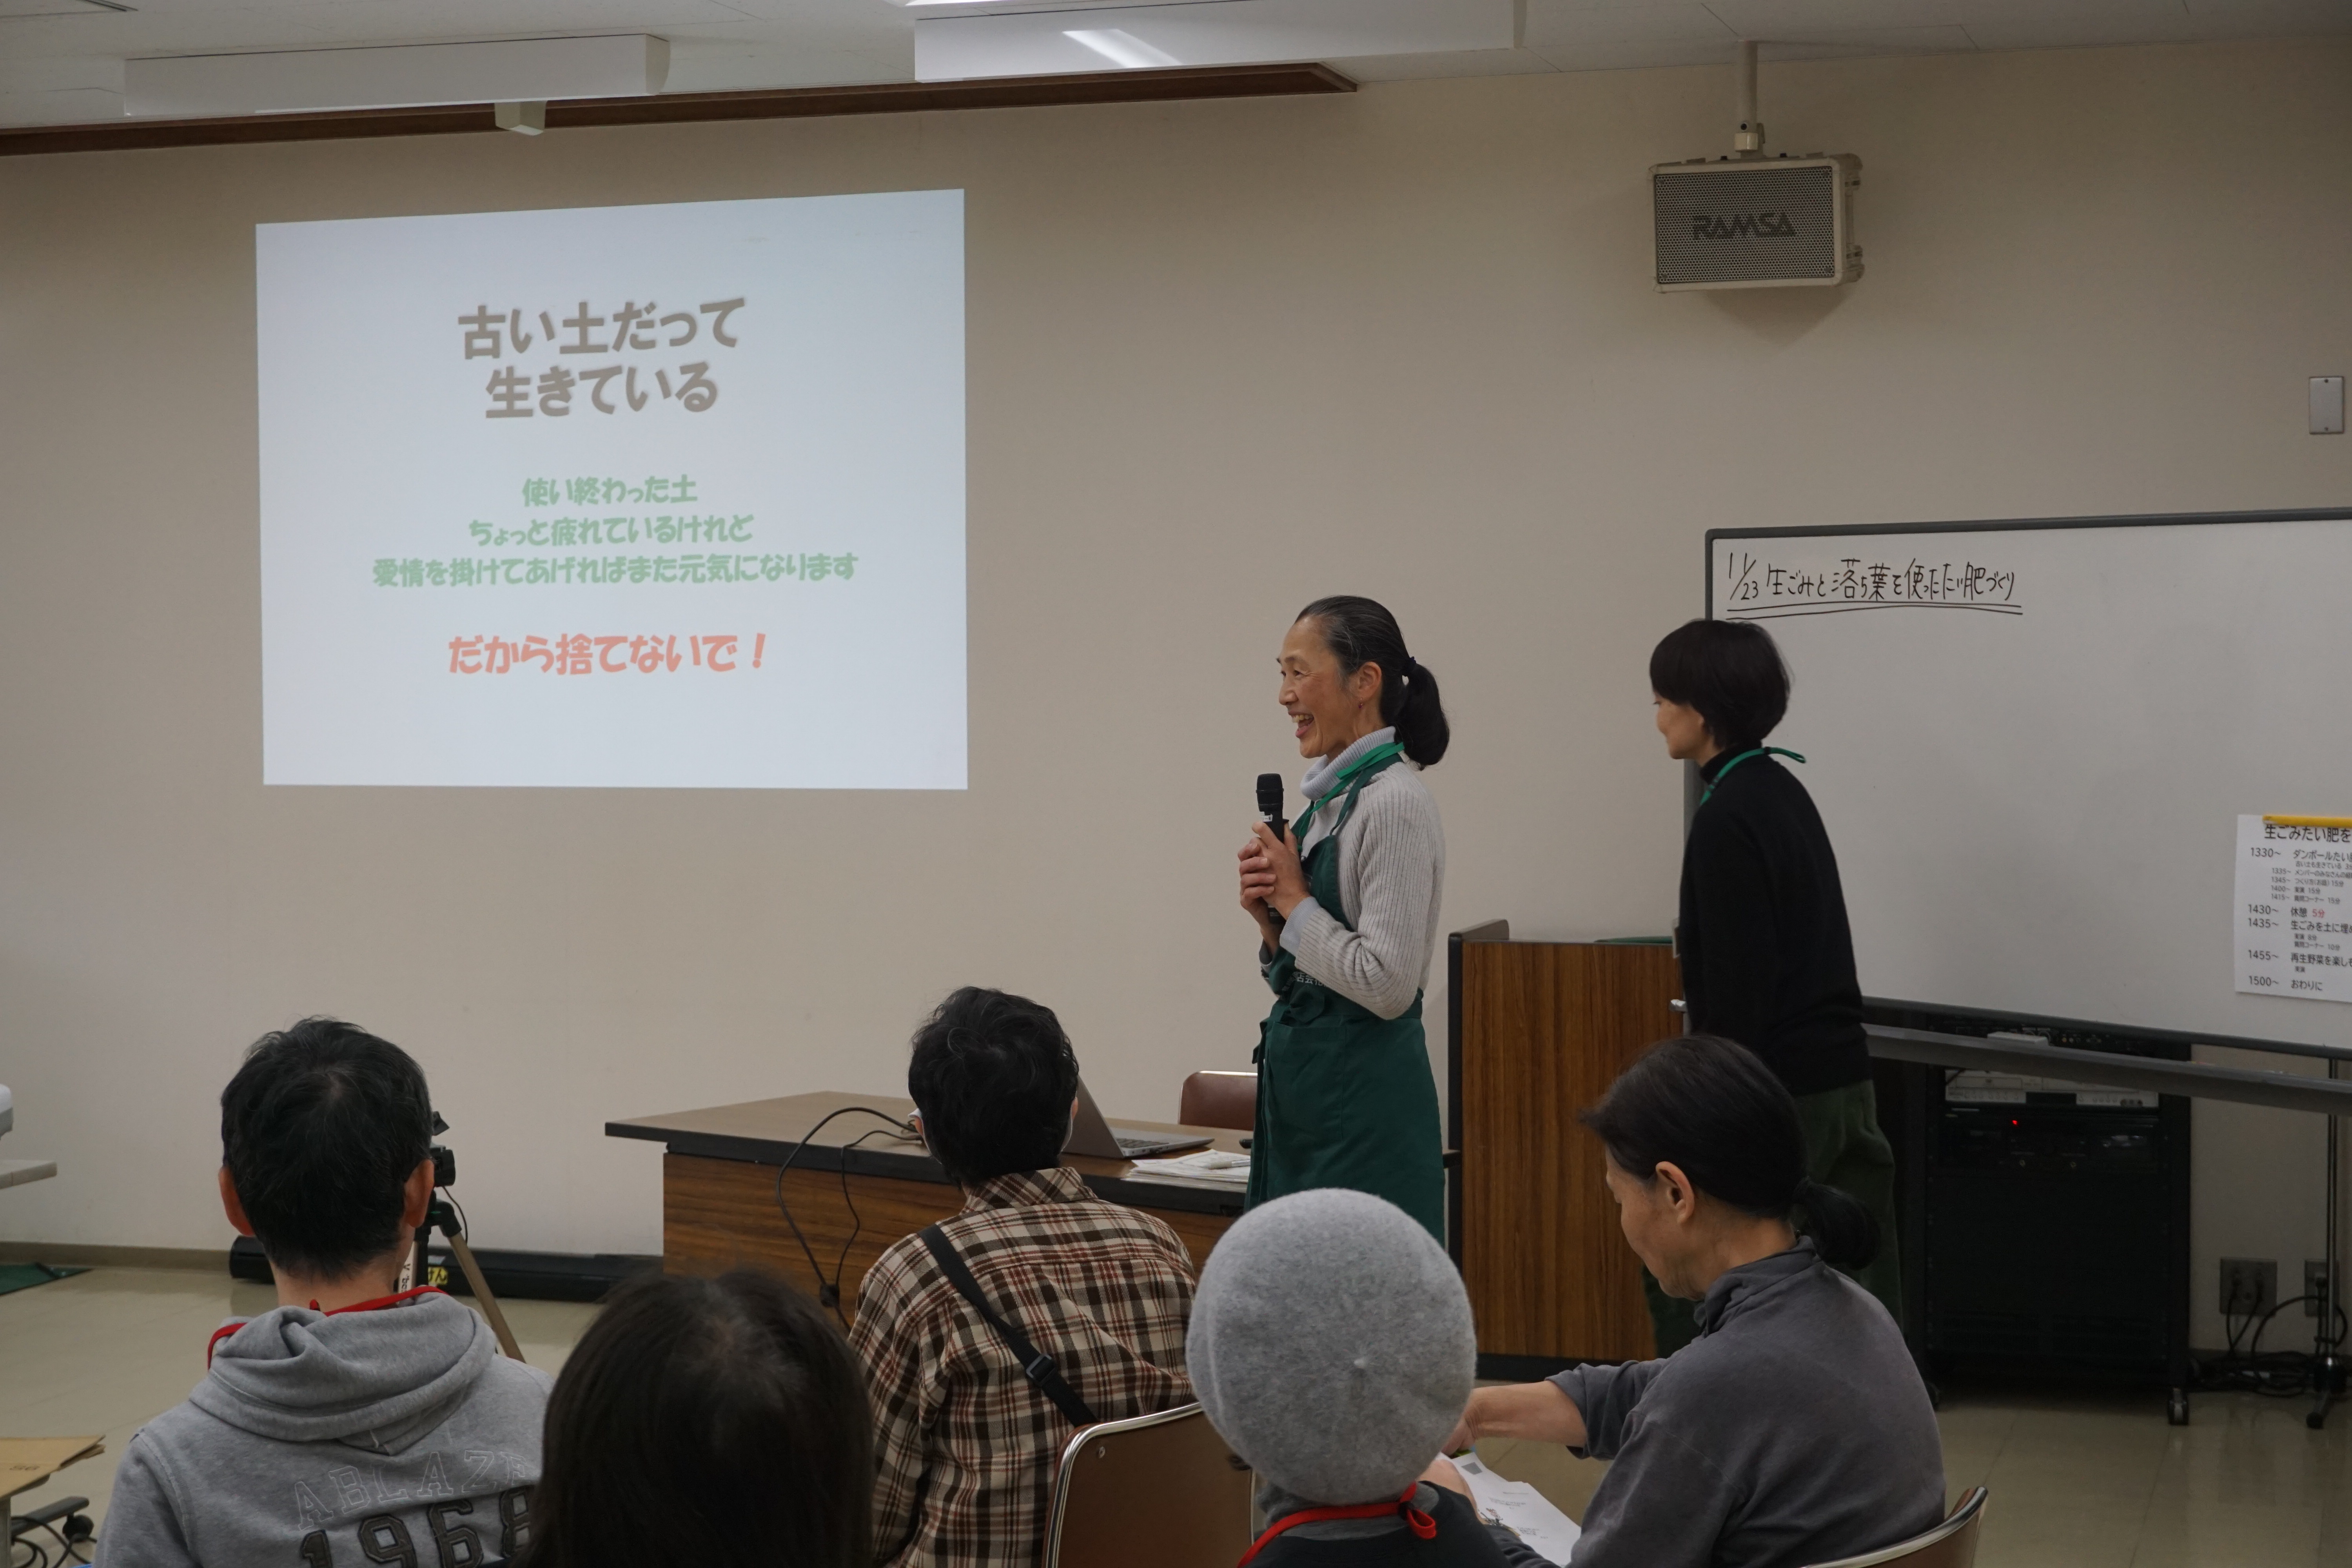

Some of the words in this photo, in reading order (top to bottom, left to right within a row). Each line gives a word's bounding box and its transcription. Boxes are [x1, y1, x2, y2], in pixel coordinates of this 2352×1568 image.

[1693, 213, 1797, 239] RAMSA
[457, 297, 745, 359] 古い土だって
[485, 361, 718, 418] 生きている
[522, 474, 698, 507] 使い終わった土
[469, 514, 754, 546] ちょっと疲れているけれど
[373, 552, 858, 587] 愛情を掛けてあげればまた元気になります
[449, 633, 766, 675] だから捨てないで！
[2291, 906, 2307, 917] 休憩
[2312, 909, 2325, 918] 5分
[2291, 980, 2323, 991] おわりに
